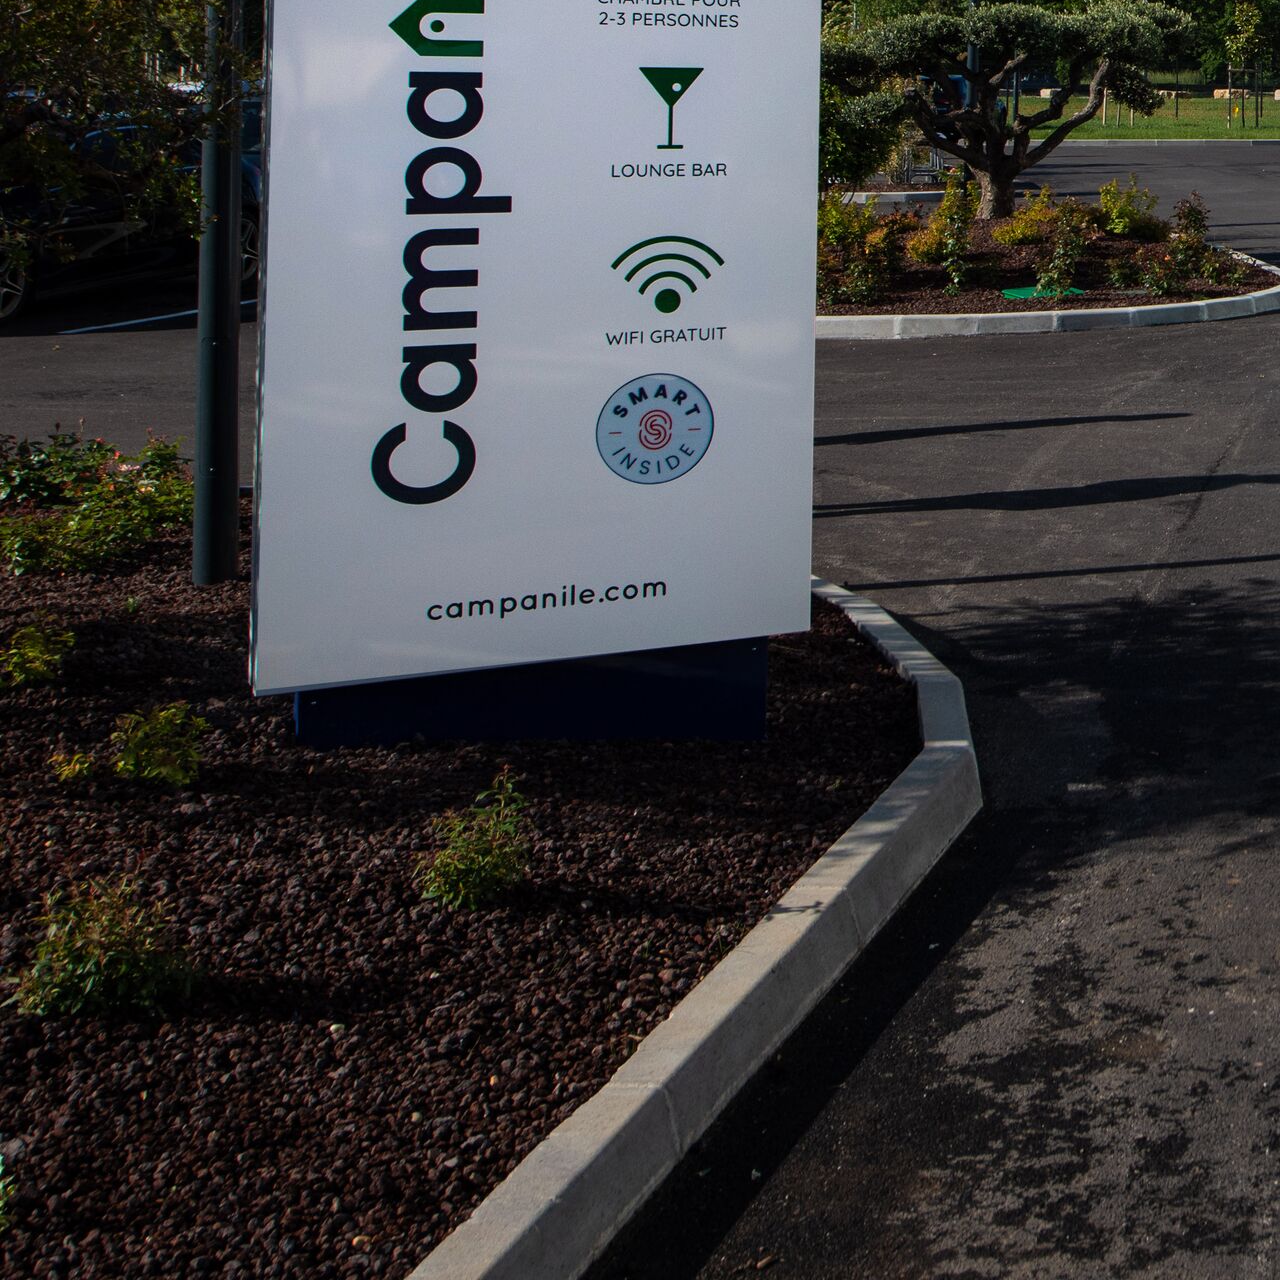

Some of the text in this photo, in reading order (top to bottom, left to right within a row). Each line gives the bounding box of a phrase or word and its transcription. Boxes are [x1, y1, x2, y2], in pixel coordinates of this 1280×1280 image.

[598, 11, 739, 28] 2-3 PERSONNES
[611, 163, 728, 178] LOUNGE BAR
[605, 326, 727, 346] WIFI GRATUIT
[612, 383, 701, 419] SMART
[612, 443, 695, 475] INSIDE
[427, 580, 668, 621] campanile.com
